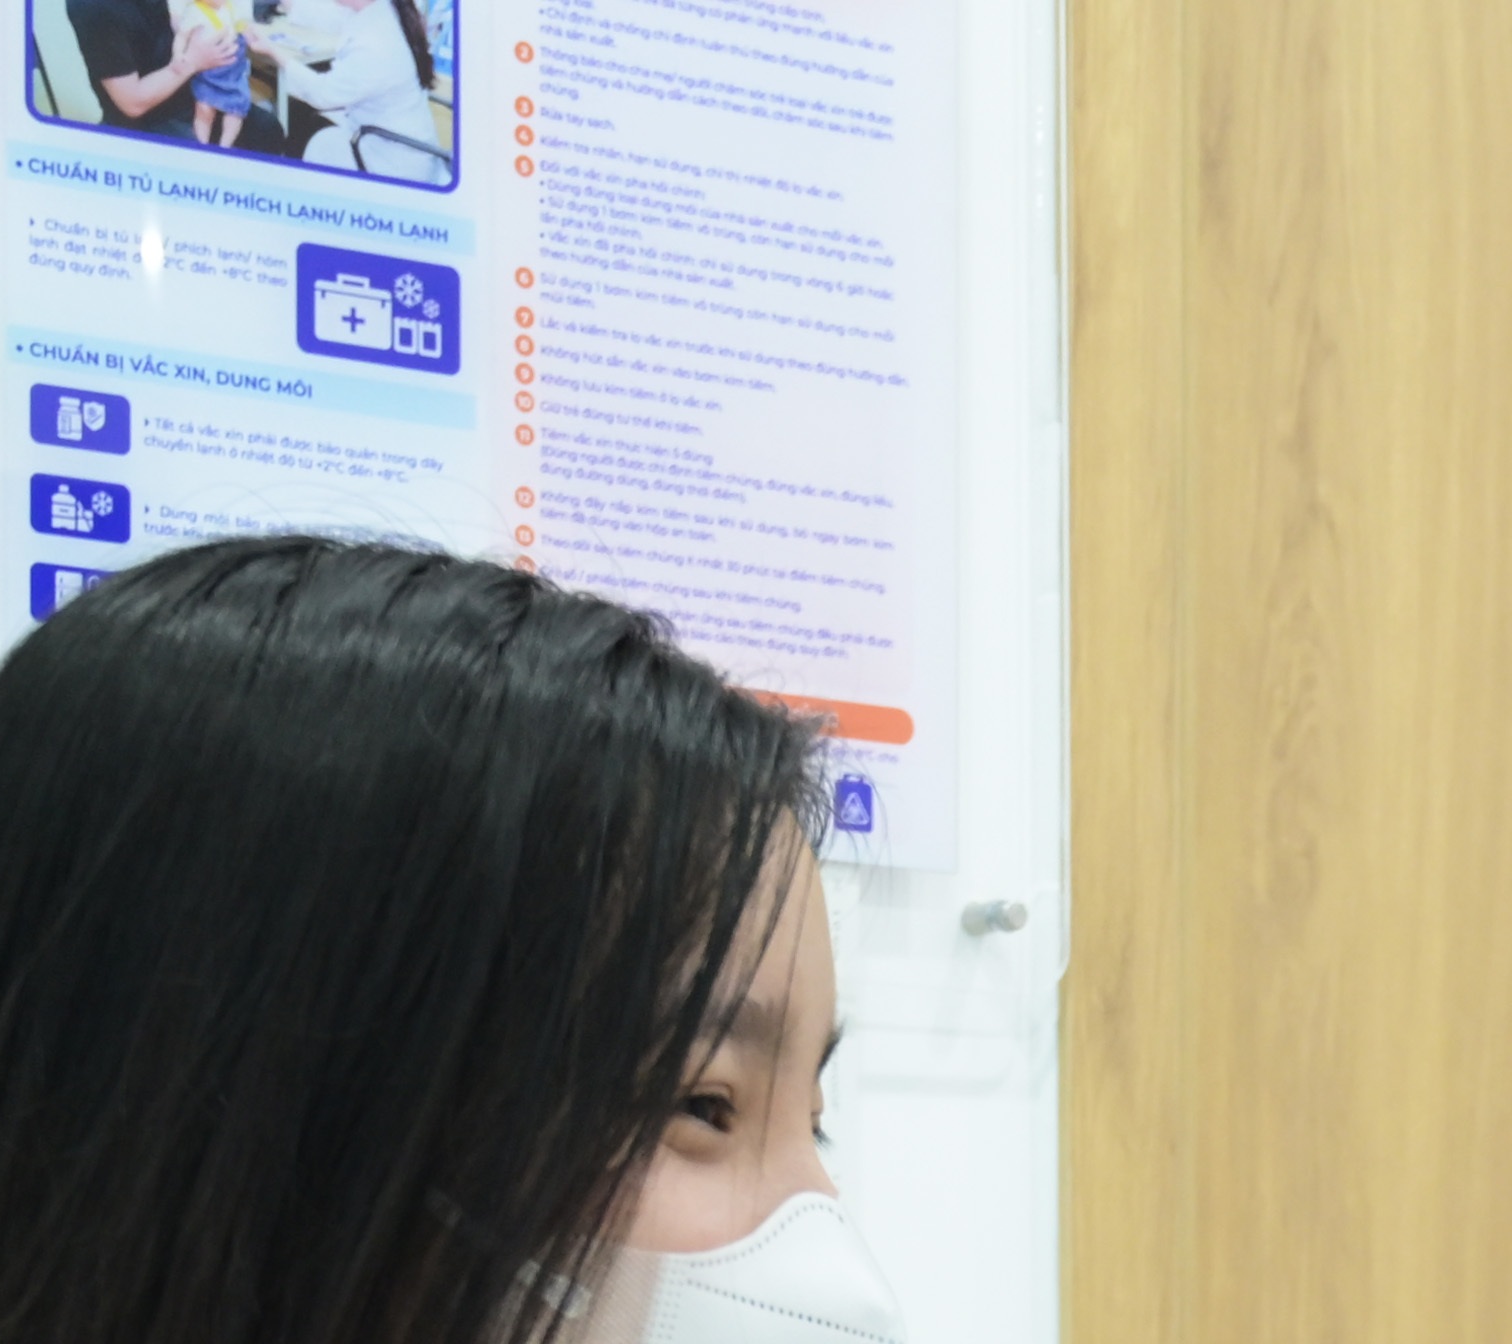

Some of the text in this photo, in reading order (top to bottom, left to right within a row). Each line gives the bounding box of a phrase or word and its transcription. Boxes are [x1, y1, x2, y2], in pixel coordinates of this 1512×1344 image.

[28, 158, 448, 242] CHUẨN BỊ TỦ LẠNH/ PHÍCH LẠNH/ HÒM LẠNH
[29, 342, 312, 398] CHUẨN BỊ VẮC XIN, DUNG MÔI
